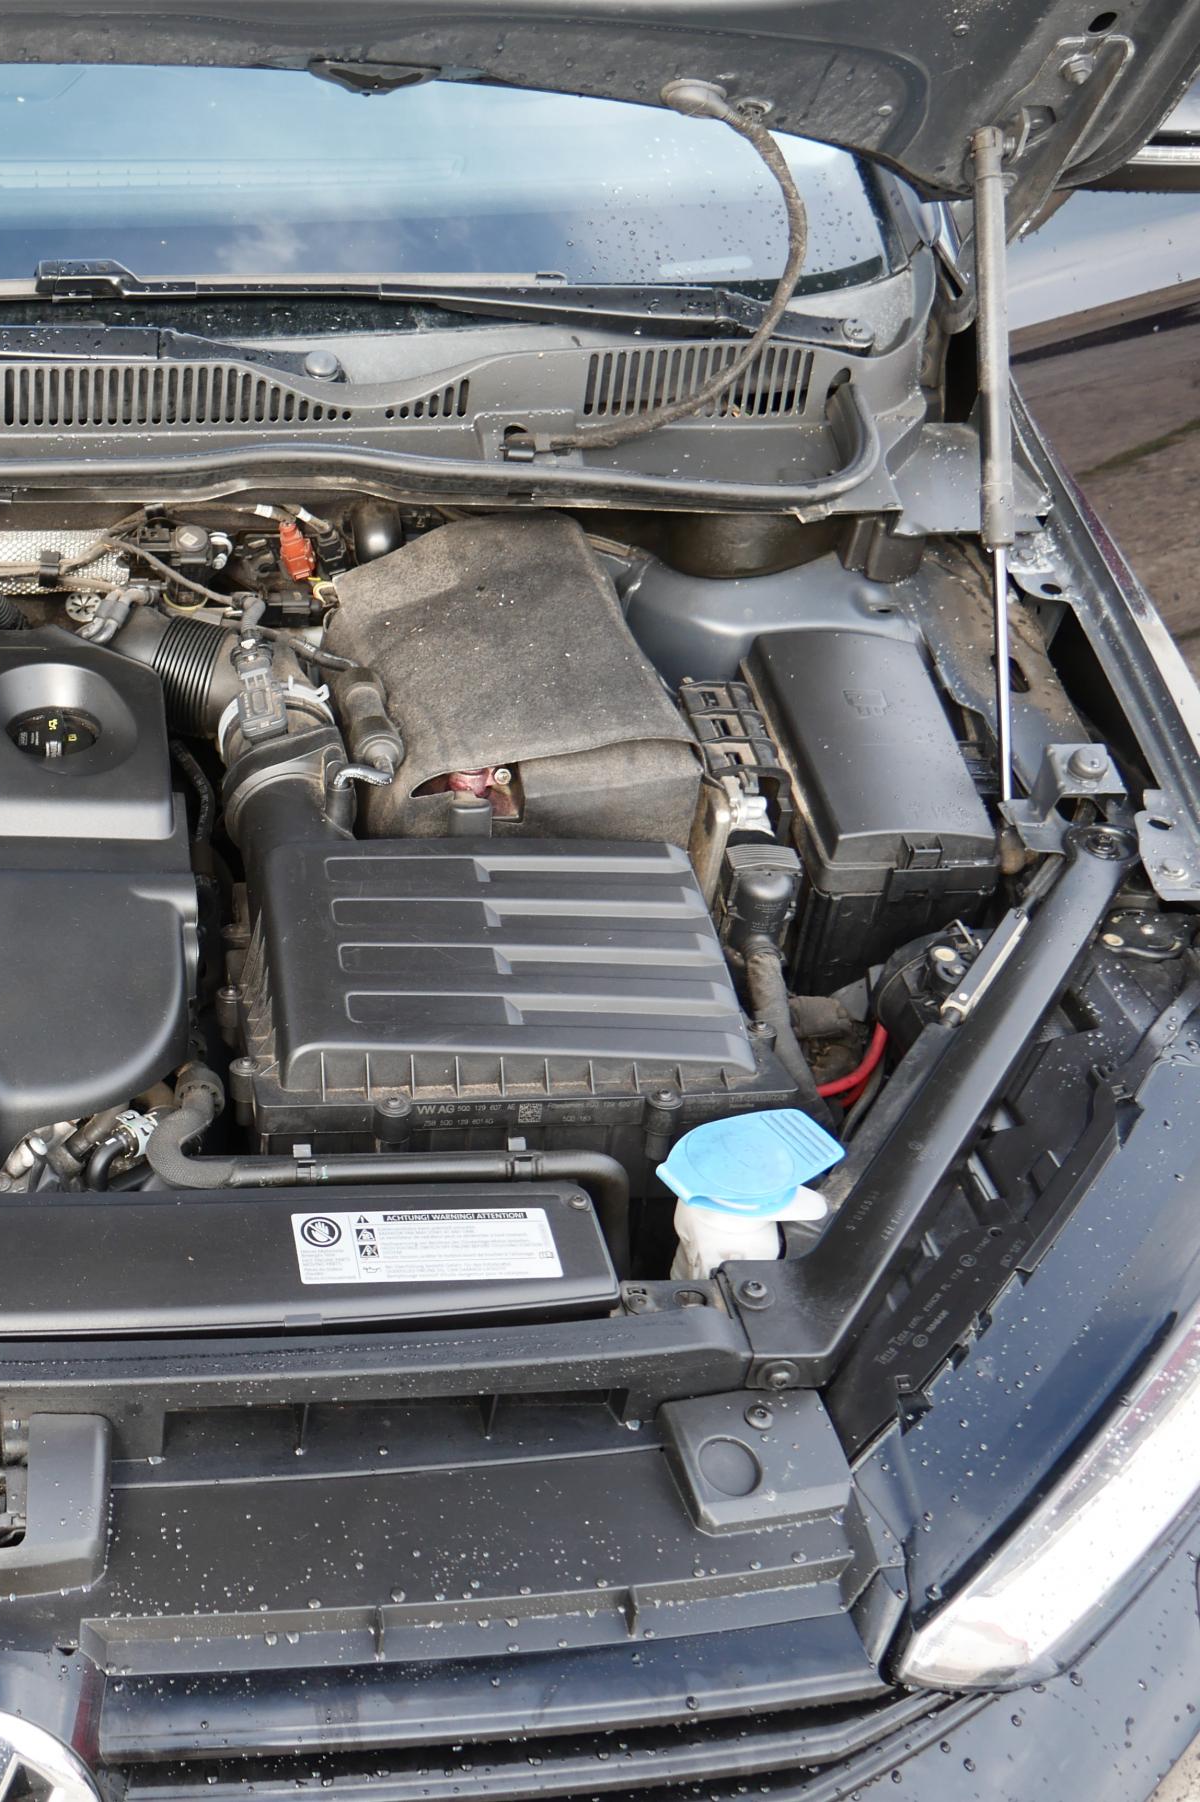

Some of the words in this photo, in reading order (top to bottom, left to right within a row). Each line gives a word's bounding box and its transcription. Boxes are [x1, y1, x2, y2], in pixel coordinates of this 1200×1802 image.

[417, 1104, 435, 1114] VW
[437, 1104, 455, 1113] AG
[476, 1211, 525, 1219] ATTENTION!
